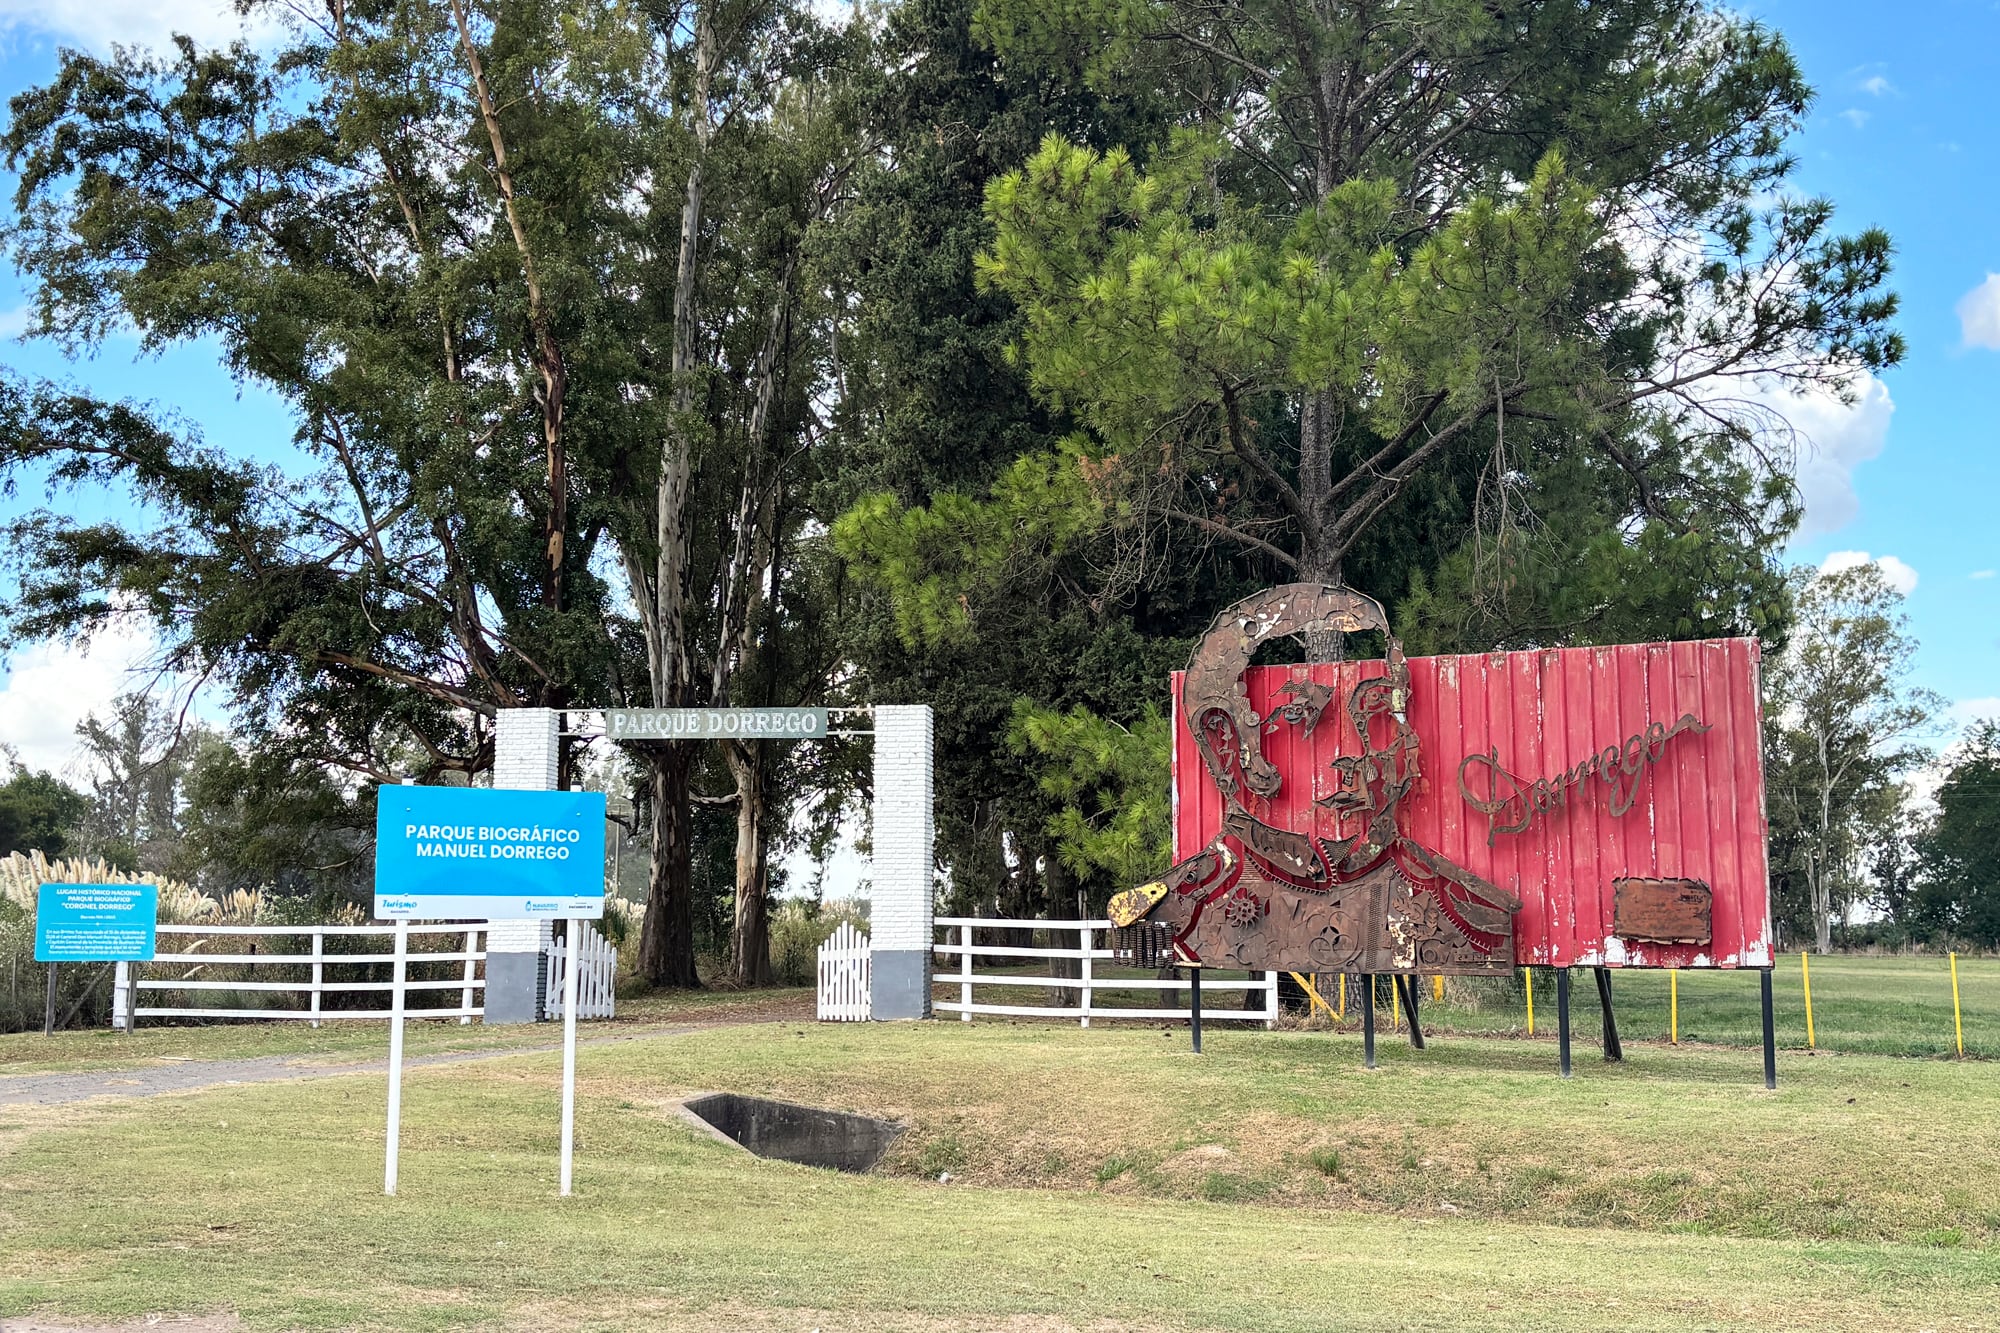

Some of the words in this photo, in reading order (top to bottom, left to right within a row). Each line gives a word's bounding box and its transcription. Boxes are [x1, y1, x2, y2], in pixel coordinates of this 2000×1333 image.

[613, 712, 701, 737] PARQUE
[707, 712, 818, 734] DORREGO
[1457, 713, 1713, 848] Dorrego
[405, 824, 475, 843] PARQUE
[478, 823, 580, 843] BIOGRÁFICO
[416, 843, 487, 859] MANUEL
[490, 844, 570, 860] DORREGO
[67, 895, 93, 903] PARQUE
[93, 895, 131, 903] BIOGRÁFICO
[382, 899, 418, 909] Turismo
